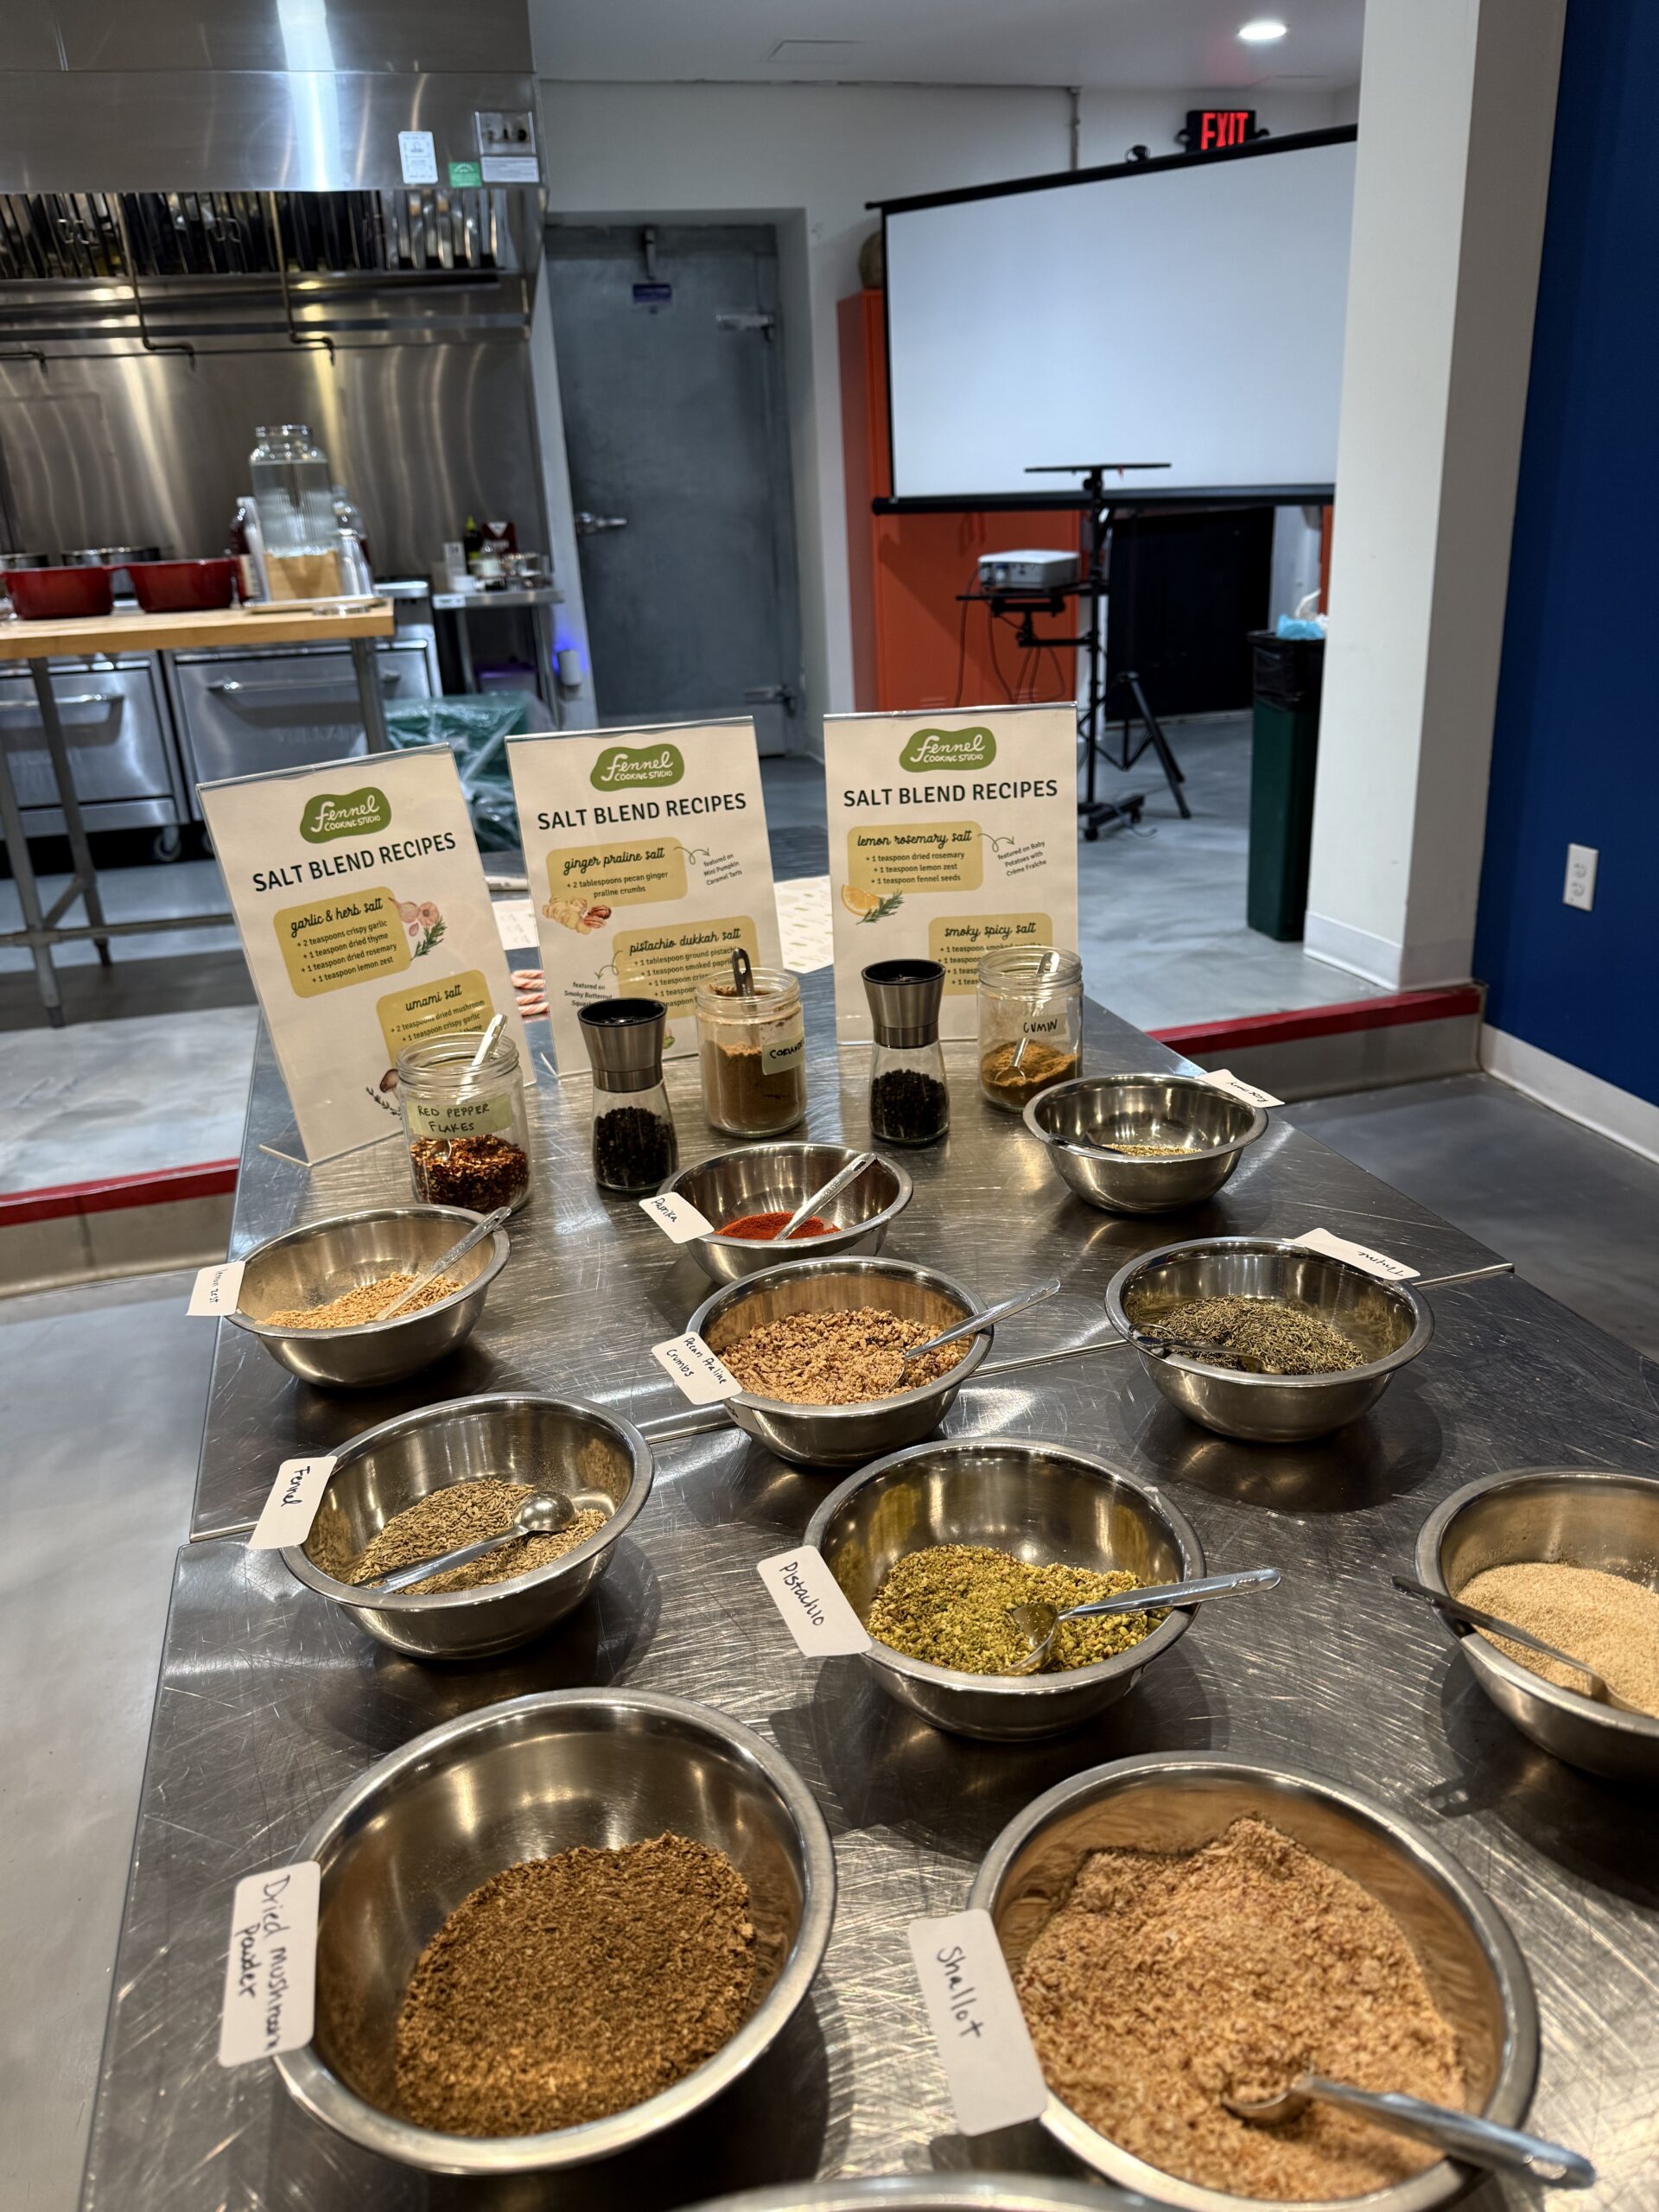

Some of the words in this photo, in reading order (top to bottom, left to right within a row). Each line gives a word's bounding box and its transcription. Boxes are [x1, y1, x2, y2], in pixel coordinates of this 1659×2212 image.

[1201, 111, 1249, 150] EXIT
[923, 753, 958, 764] COOKING
[958, 753, 983, 763] STUDIO
[614, 772, 648, 782] COOKING
[648, 770, 673, 779] STUDIO
[843, 788, 893, 807] SALT
[899, 785, 966, 805] BLEND
[972, 779, 1058, 801] RECIPES
[537, 809, 588, 830] SALT
[594, 802, 660, 824] BLEND
[666, 792, 747, 817] RECIPES
[324, 819, 358, 832] COOKING
[358, 815, 381, 827] STUDIO
[857, 835, 891, 847] lemon
[894, 833, 949, 849] rosemary
[952, 830, 972, 842] salt
[878, 854, 910, 862] teaspoon
[931, 851, 965, 860] rosemary
[997, 848, 1021, 860] featured
[1030, 841, 1046, 849] Baby
[1004, 856, 1030, 868] Potatoes
[1030, 850, 1044, 860] with
[252, 865, 303, 892] SALT
[308, 850, 375, 880] BLEND
[378, 832, 456, 864] RECIPES
[563, 856, 601, 875] ginger
[603, 849, 642, 868] praline
[645, 847, 664, 860] salt
[703, 855, 726, 868] featured
[703, 868, 716, 877] Mini
[716, 861, 740, 874] Pumpkin
[886, 865, 918, 874] teaspoon
[579, 877, 622, 890] tablespoons
[624, 874, 645, 885] pecan
[645, 871, 668, 882] ginger
[706, 875, 728, 887] Caramel
[729, 869, 743, 879] Tarts
[882, 877, 916, 886] teaspoon
[917, 874, 939, 883] fennel
[594, 888, 619, 899] praline
[620, 885, 646, 895] crumbs
[290, 914, 324, 938] garlic
[326, 909, 334, 922] &
[336, 904, 361, 920] herb
[364, 898, 384, 912] salt
[309, 931, 346, 946] teaspoons
[346, 925, 367, 936] crispy
[368, 919, 388, 932] garlic
[629, 939, 677, 956] pistachio
[680, 931, 719, 946] dukkah
[722, 928, 741, 940] salt
[944, 925, 981, 942] smoky
[985, 925, 1013, 940] spicy
[1016, 922, 1036, 933] salt
[315, 944, 348, 957] teaspoon
[348, 937, 366, 948] dried
[367, 932, 389, 944] thyme
[951, 944, 984, 953] teaspoon
[313, 957, 346, 971] teaspoon
[346, 950, 365, 962] dried
[366, 944, 397, 957] rosemary
[645, 954, 684, 965] tablespoon
[685, 950, 709, 961] ground
[710, 946, 741, 957] pistach
[324, 966, 357, 981] teaspoon
[357, 961, 378, 972] lemon
[380, 957, 394, 966] zest
[652, 966, 684, 976] teaspoon
[685, 961, 711, 970] smoked
[712, 959, 734, 969] paprik
[660, 976, 691, 986] teaspoon
[405, 991, 442, 1012] umami
[445, 984, 462, 1000] salt
[435, 1009, 452, 1020] dried
[453, 1000, 486, 1014] mushroom
[413, 1026, 442, 1039] teaspoon
[443, 1019, 462, 1030] crispy
[462, 1013, 480, 1025] garlic
[1023, 1018, 1058, 1033] CUMIN
[417, 1105, 440, 1116] RED
[447, 1103, 490, 1118] PEPPER
[429, 1121, 475, 1134] FLAKES
[651, 1198, 677, 1223] Paprika
[1357, 1250, 1404, 1277] Thyme
[666, 1349, 695, 1377] Crumbs
[683, 1337, 703, 1358] Pecan
[702, 1357, 728, 1384] Praline
[281, 1465, 311, 1507] Fennel
[779, 1561, 825, 1626] Pistachio
[261, 1874, 291, 1937] Dried
[937, 1946, 984, 2038] Shallot
